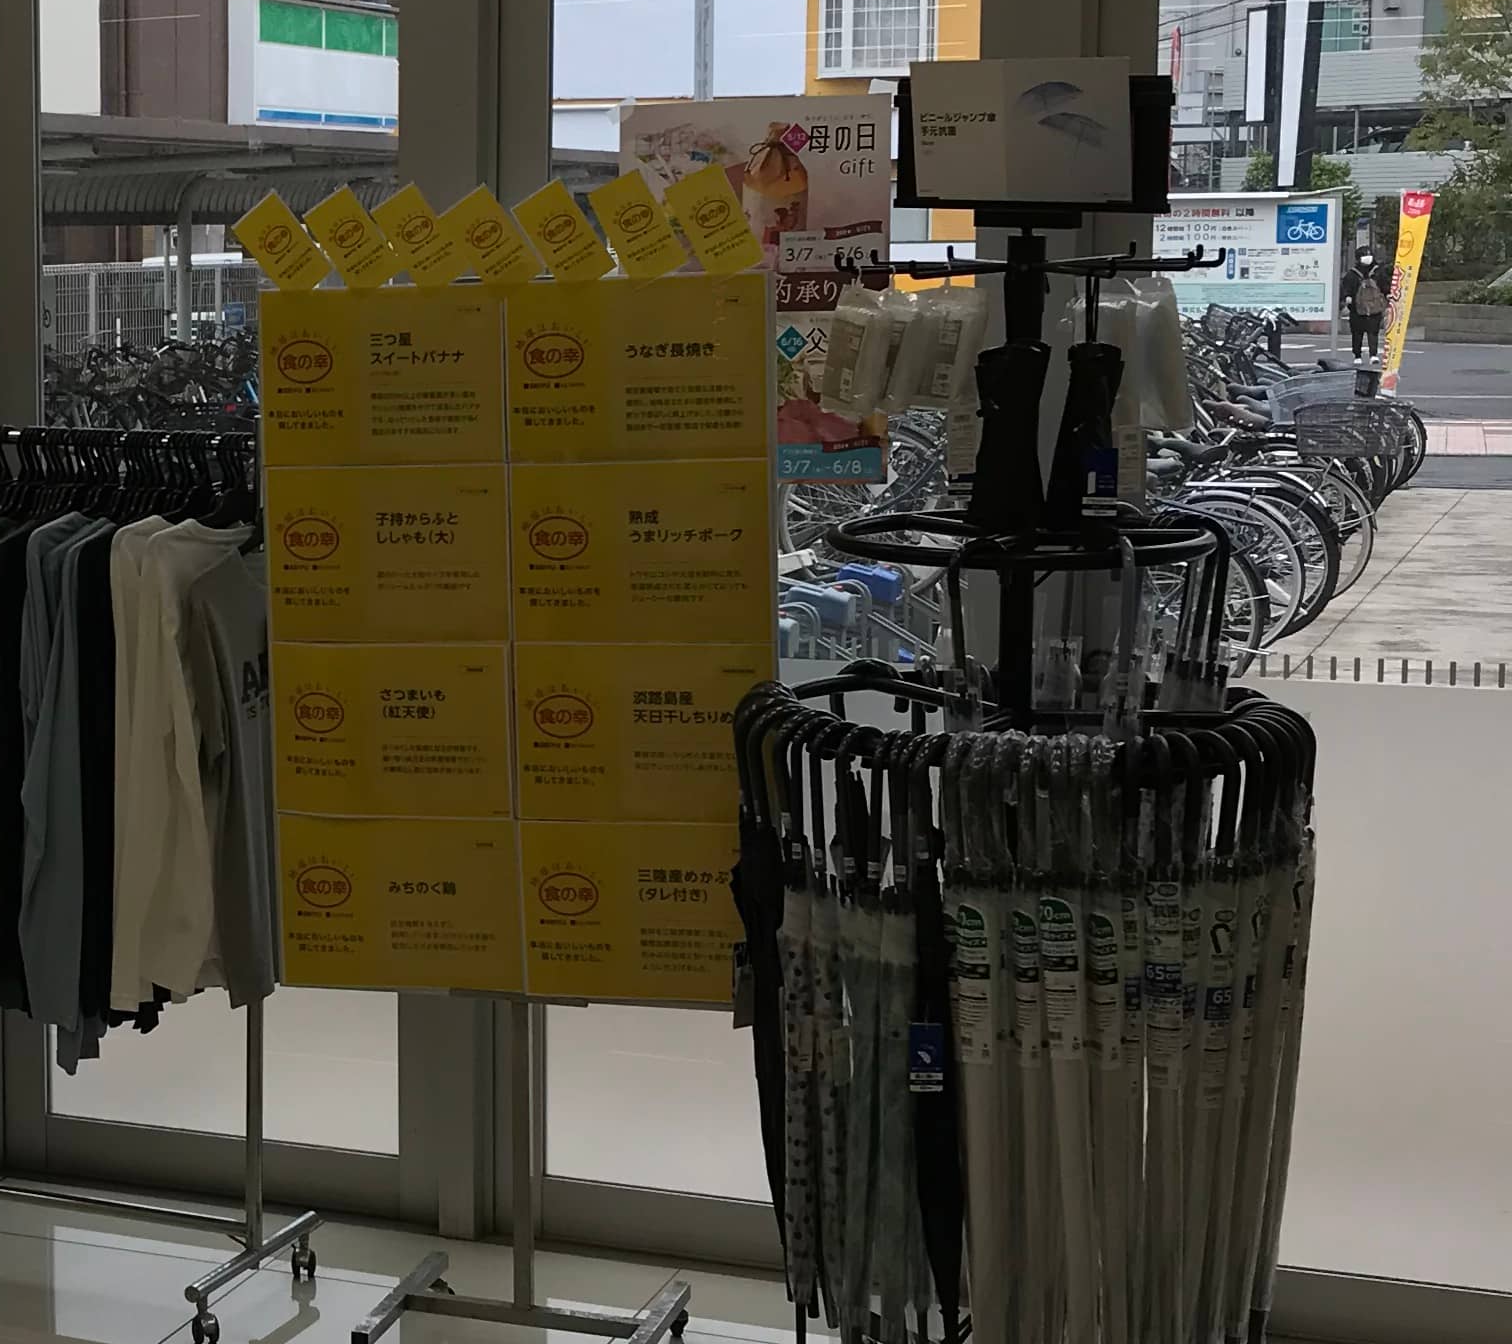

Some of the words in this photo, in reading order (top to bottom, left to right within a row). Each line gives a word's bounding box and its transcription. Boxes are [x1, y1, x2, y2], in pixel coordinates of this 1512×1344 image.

[809, 123, 875, 153] 母の日
[839, 158, 875, 178] Gift
[370, 332, 412, 347] 三つ星
[370, 350, 464, 365] スイートバナナ
[528, 348, 580, 365] 食の幸
[625, 342, 715, 358] うなぎ長焼き
[282, 353, 329, 370] 食の幸
[783, 459, 811, 474] 3/7
[376, 511, 459, 527] 子持からふと
[628, 510, 659, 525] 熟成
[289, 531, 335, 547] 食の幸
[534, 530, 585, 546] 食の幸
[629, 528, 743, 543] うまリッチポーク
[380, 688, 446, 702] さつまいも
[299, 705, 340, 720] 食の幸
[538, 708, 589, 725] 食の幸
[632, 709, 734, 724] 天日干しちりめ
[301, 879, 348, 895] 食の幸
[544, 886, 594, 902] 食の幸
